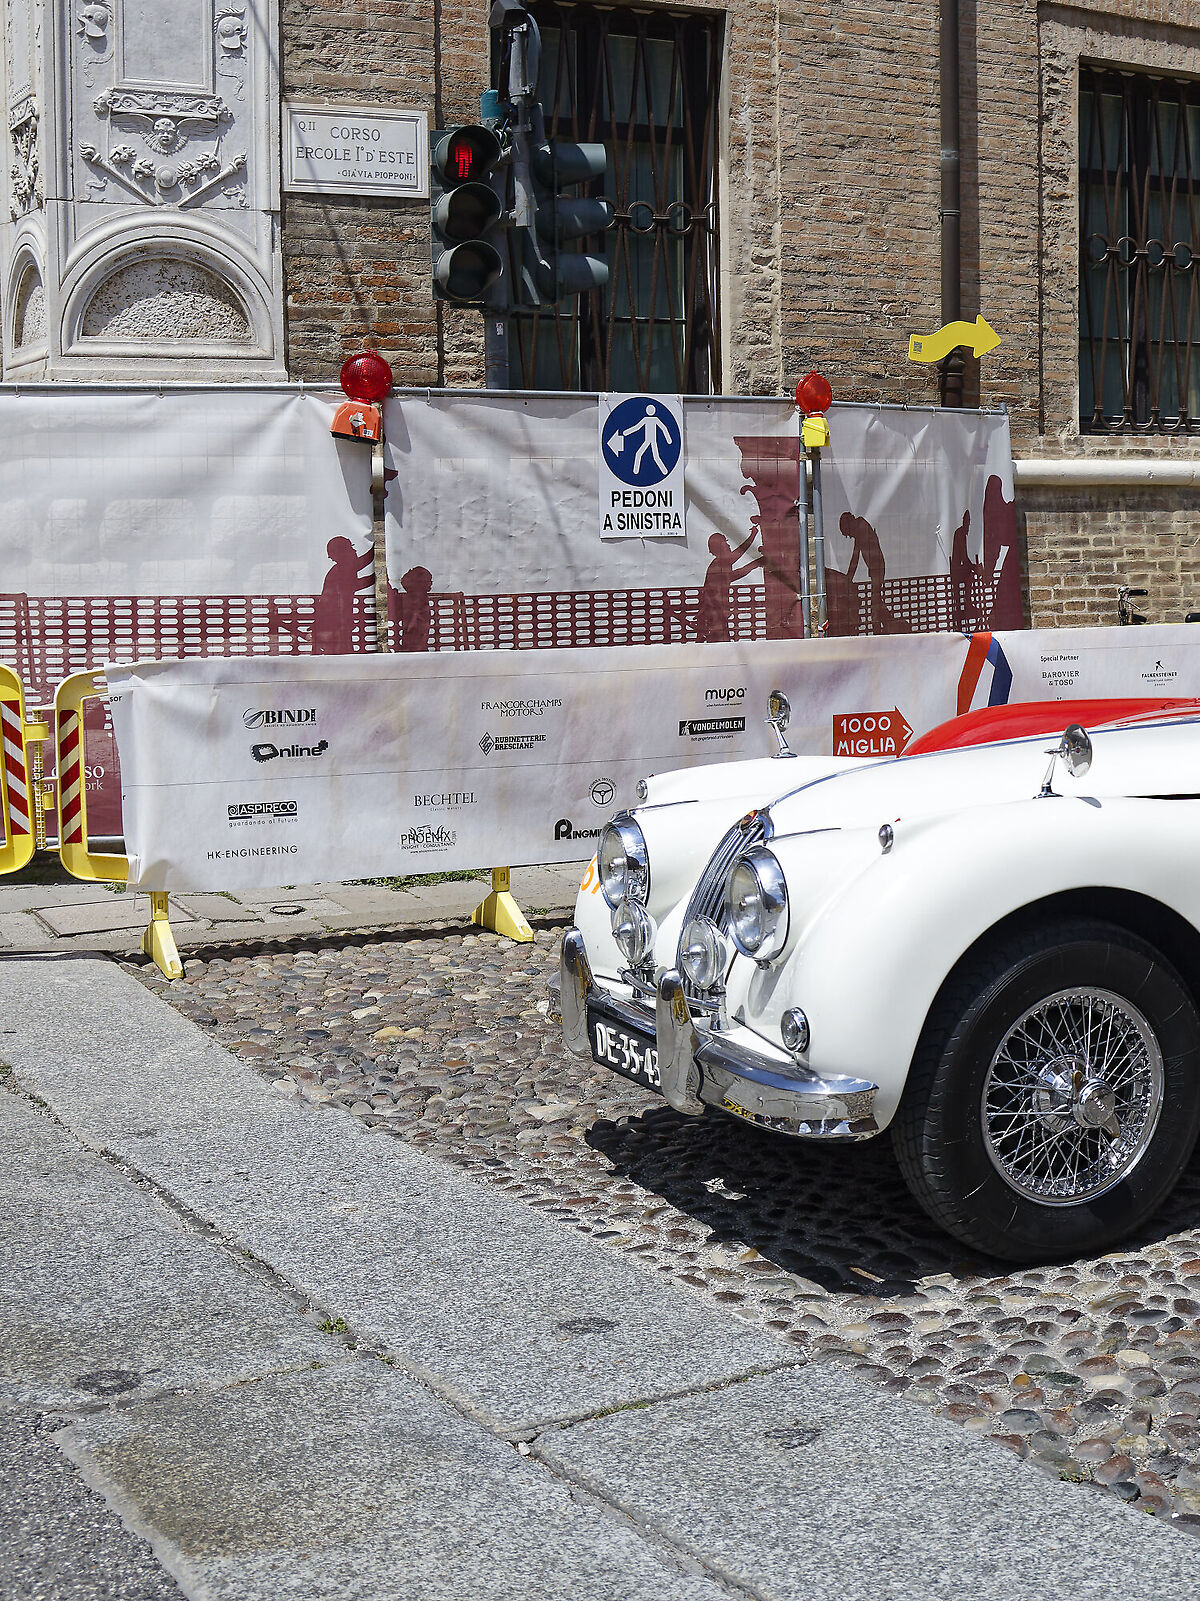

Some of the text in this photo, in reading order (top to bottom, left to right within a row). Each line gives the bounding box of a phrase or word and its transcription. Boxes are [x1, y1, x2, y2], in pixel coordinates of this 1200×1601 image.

[330, 126, 381, 141] CORSO
[296, 146, 351, 161] ERCOLE
[611, 490, 673, 508] PEDONI
[603, 512, 682, 531] A SINISTRA
[1040, 655, 1059, 663] Special
[1042, 670, 1080, 679] BAROVIER
[705, 688, 745, 701] mupa
[481, 699, 562, 710] FRANCORCHAMPS
[500, 707, 544, 717] MOTORS
[264, 708, 317, 724] BINDI
[692, 720, 743, 732] VONDELMOLEN
[840, 716, 891, 734] 1000
[494, 735, 547, 743] RUBINETTERIE
[837, 736, 896, 756] MIGLIA
[494, 743, 534, 751] BRESCIANE
[414, 792, 478, 807] BECHTEL
[239, 802, 297, 815] ASPIRECO
[554, 819, 603, 841] RINGMI
[207, 845, 298, 860] HK-ENGINEERING
